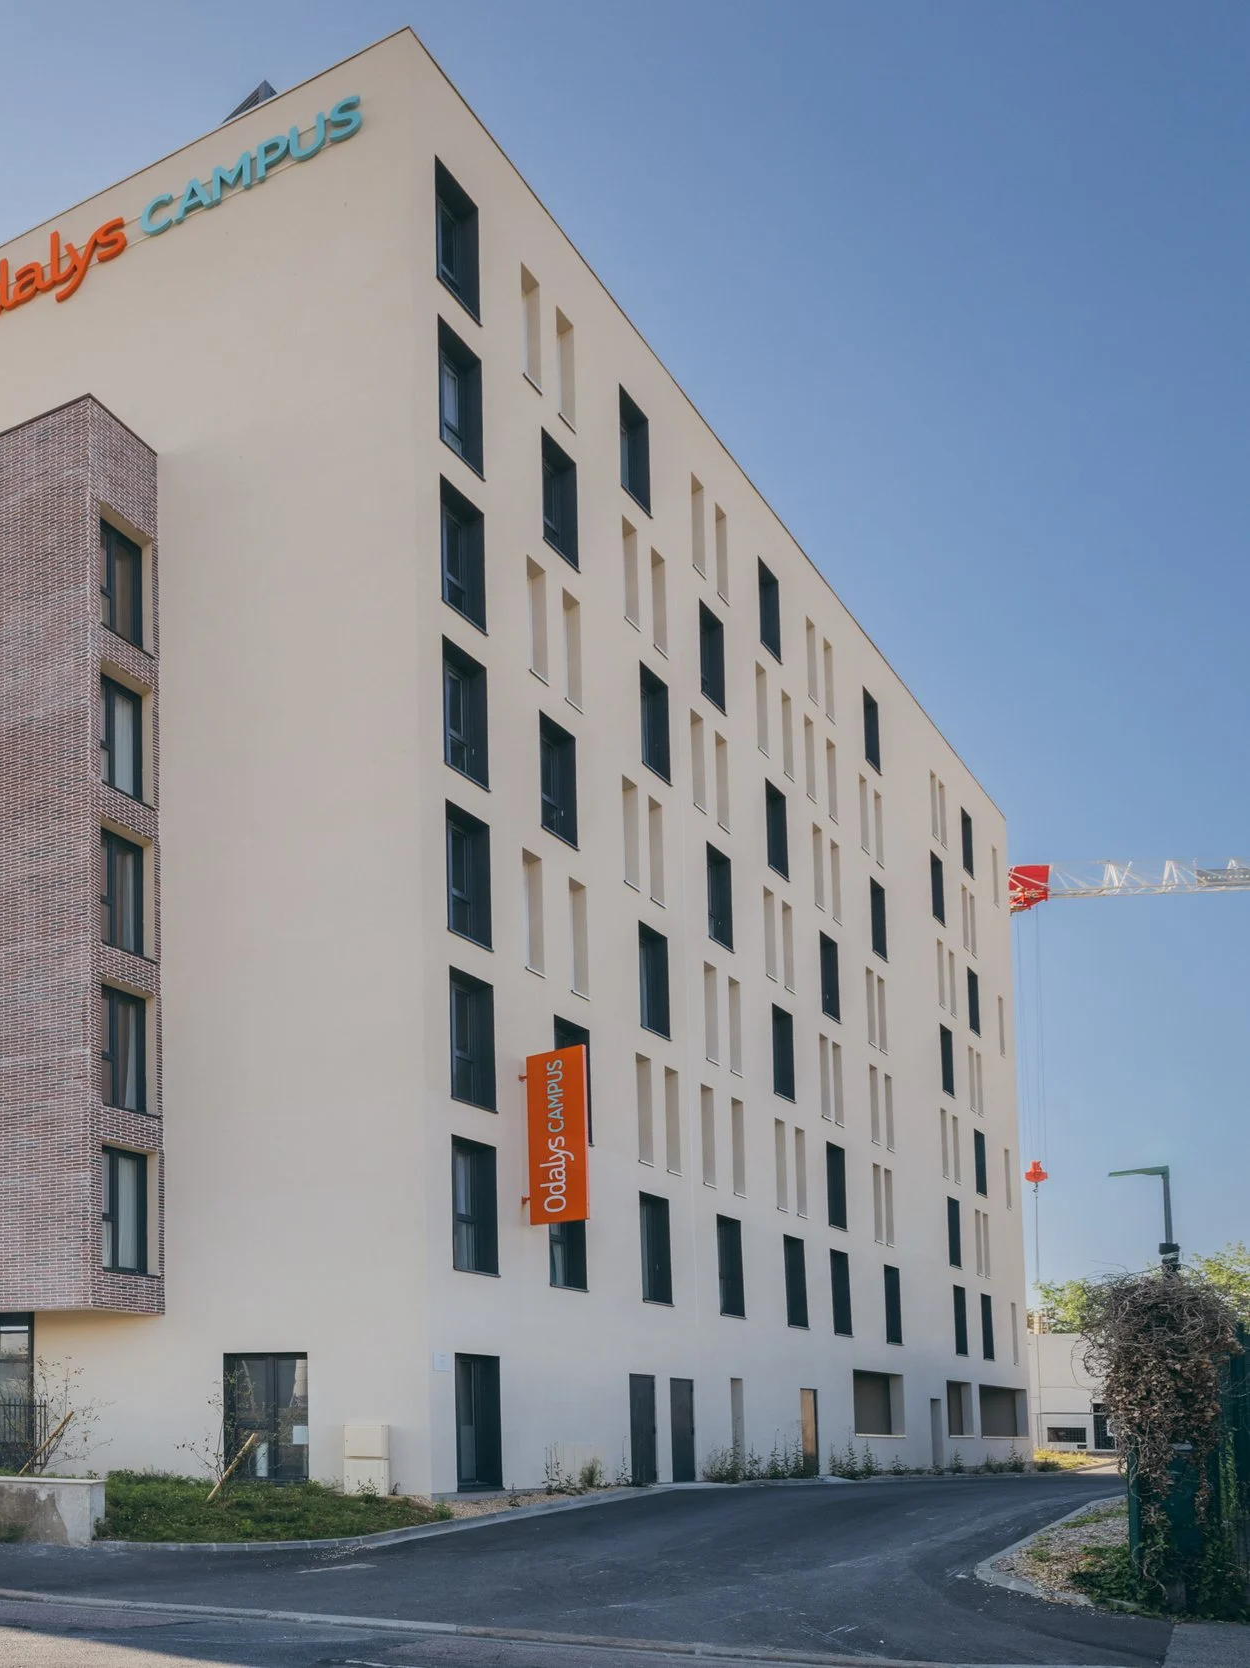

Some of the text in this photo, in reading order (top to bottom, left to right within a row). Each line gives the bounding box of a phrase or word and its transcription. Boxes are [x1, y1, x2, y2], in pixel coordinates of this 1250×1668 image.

[140, 95, 363, 236] CAMPUS
[539, 1059, 574, 1213] Odalys CAMPUS
